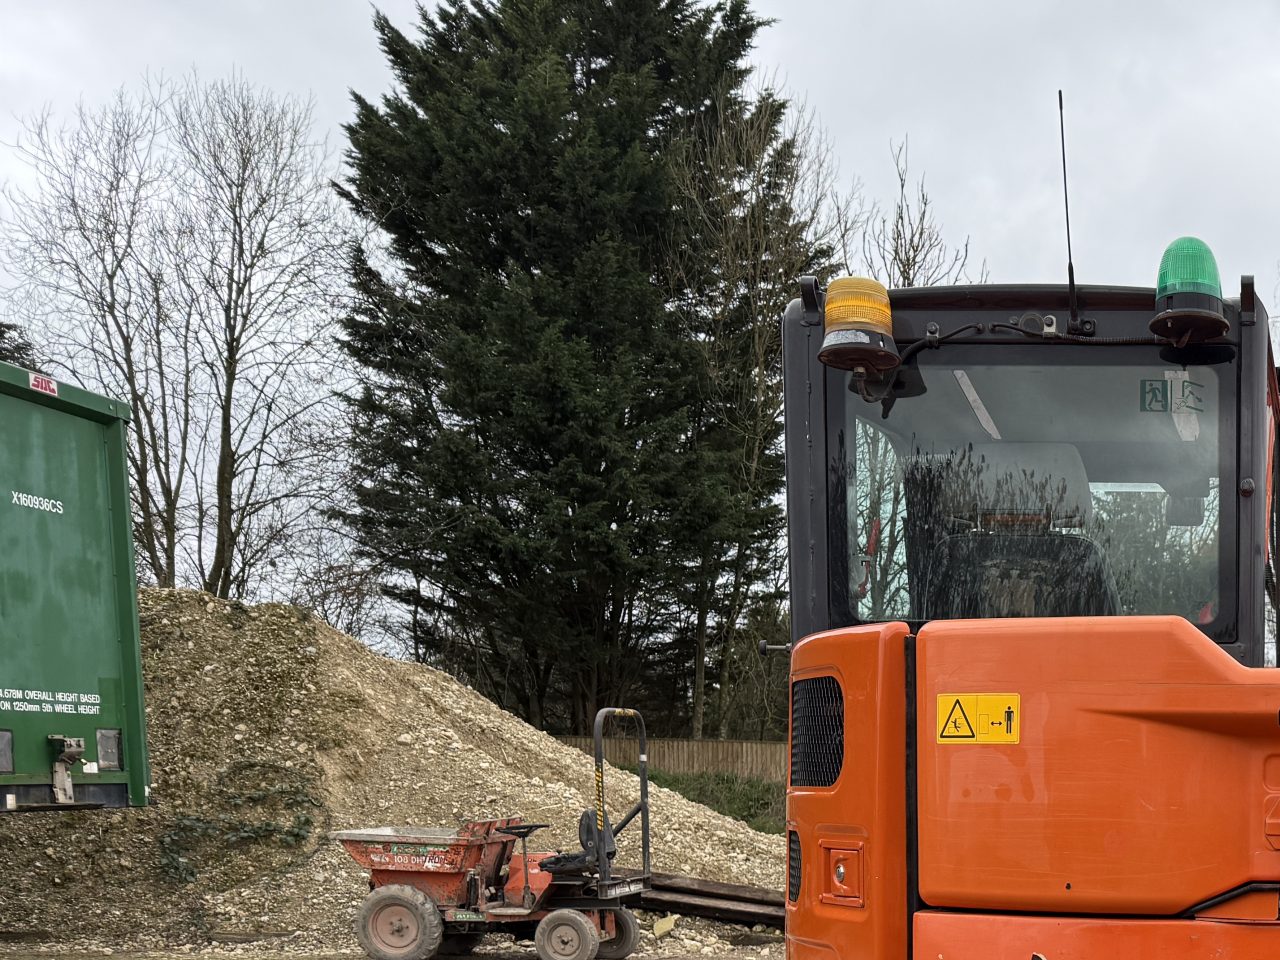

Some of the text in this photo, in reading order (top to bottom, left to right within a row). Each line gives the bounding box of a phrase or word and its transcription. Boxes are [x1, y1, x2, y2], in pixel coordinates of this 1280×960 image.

[11, 490, 64, 514] X160936CS
[24, 690, 55, 701] OVERALL
[55, 692, 79, 702] HEIGHT
[79, 693, 101, 704] BASED
[0, 700, 101, 715] ON 1250mm 5th WHEEL HEIGHT
